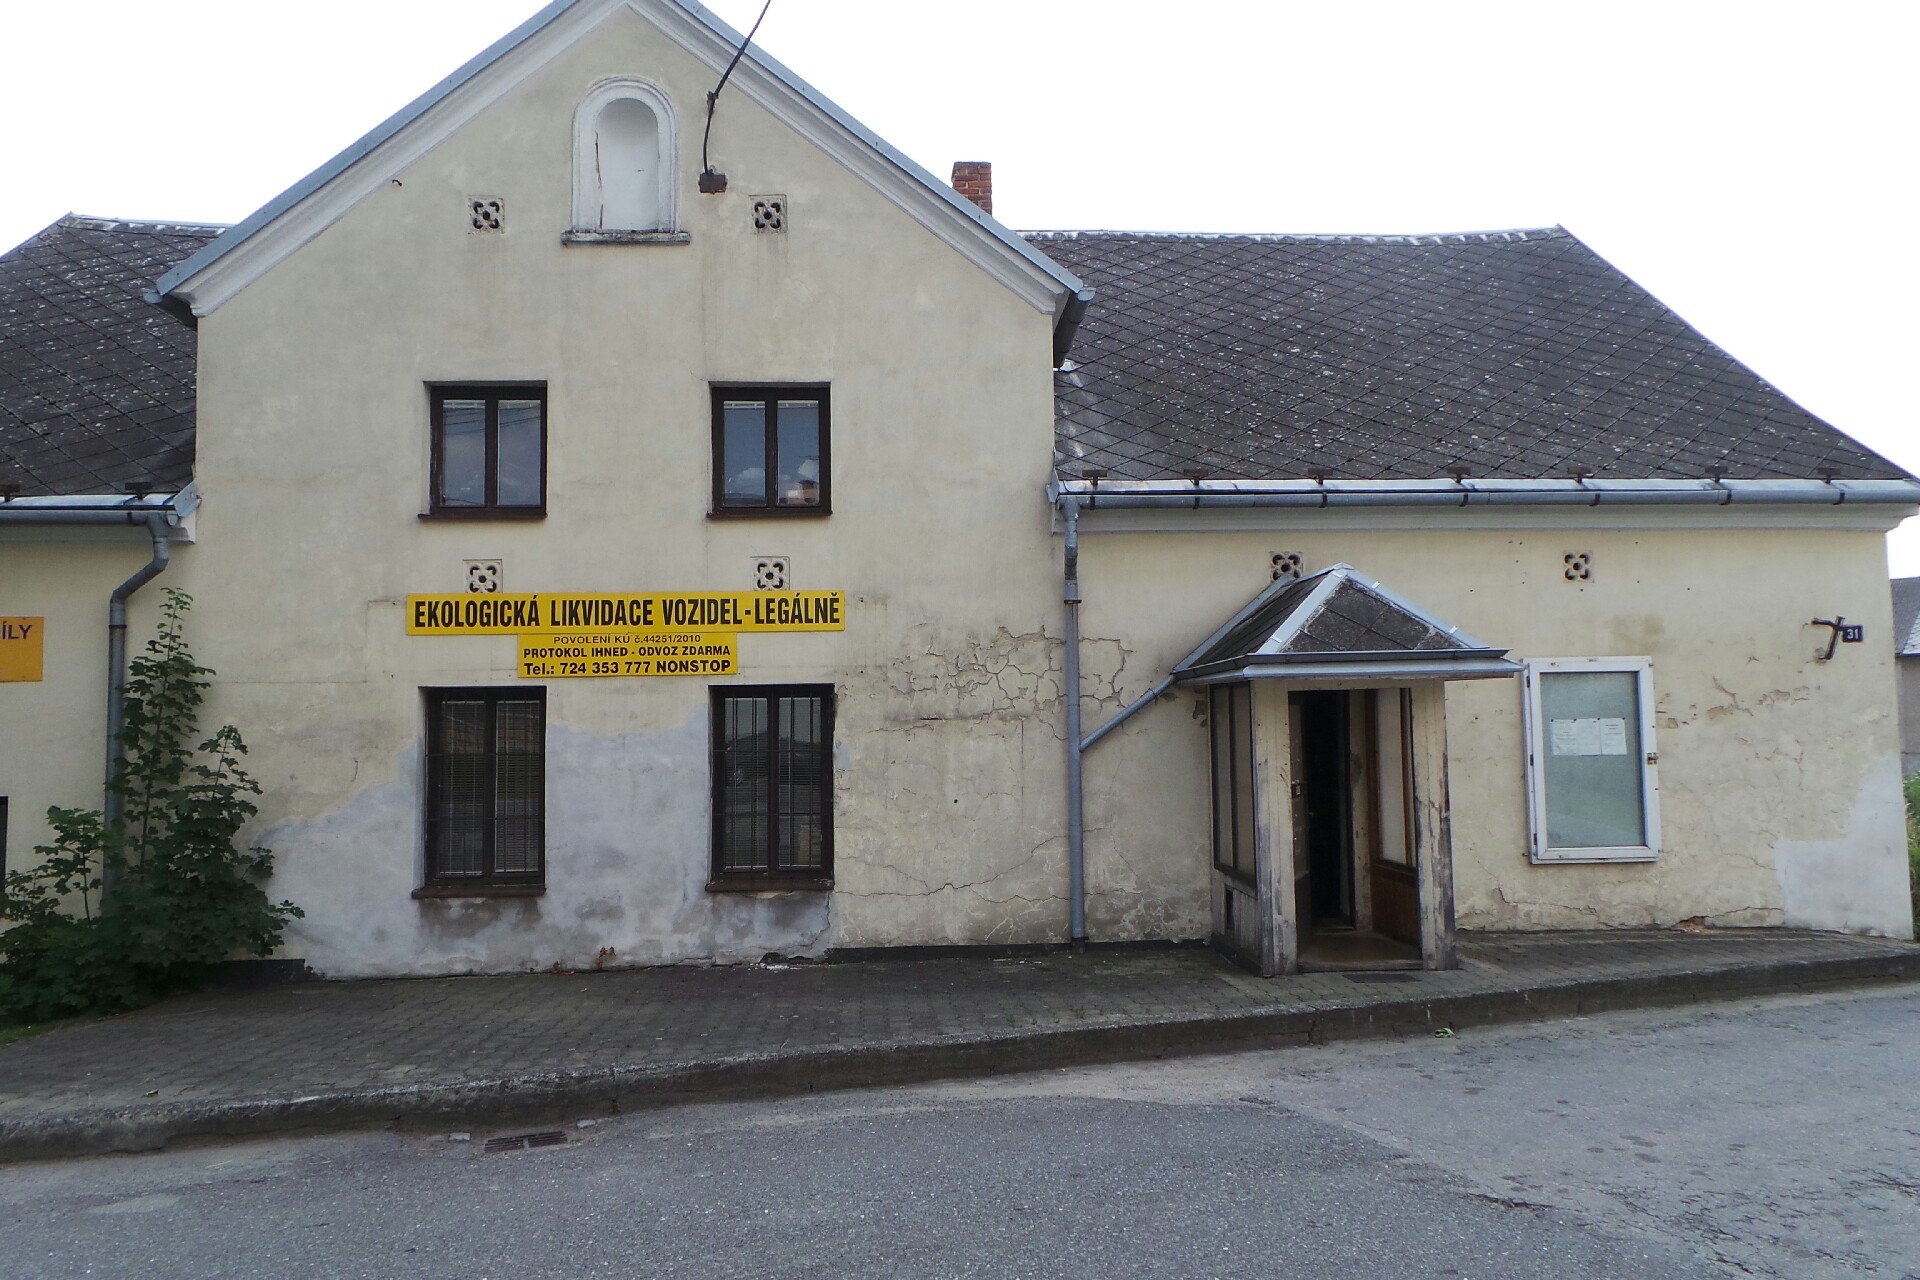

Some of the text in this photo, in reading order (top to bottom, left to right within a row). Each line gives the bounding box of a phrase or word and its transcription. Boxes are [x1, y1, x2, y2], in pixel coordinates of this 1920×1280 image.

[414, 594, 541, 628] EKOLOGICKÁ
[550, 599, 653, 627] LIKVIDACE
[0, 620, 33, 640] ÍLY
[553, 631, 701, 644] POVOLENÍ KÚ č.44251/2010
[1847, 628, 1859, 639] 31
[523, 647, 588, 659] PROTOKOL
[591, 647, 628, 657] IHNED
[638, 646, 678, 657] ODVOZ
[682, 645, 731, 656] ZDARMA
[524, 659, 731, 675] Tel.: 724 353 777 NONSTOP
